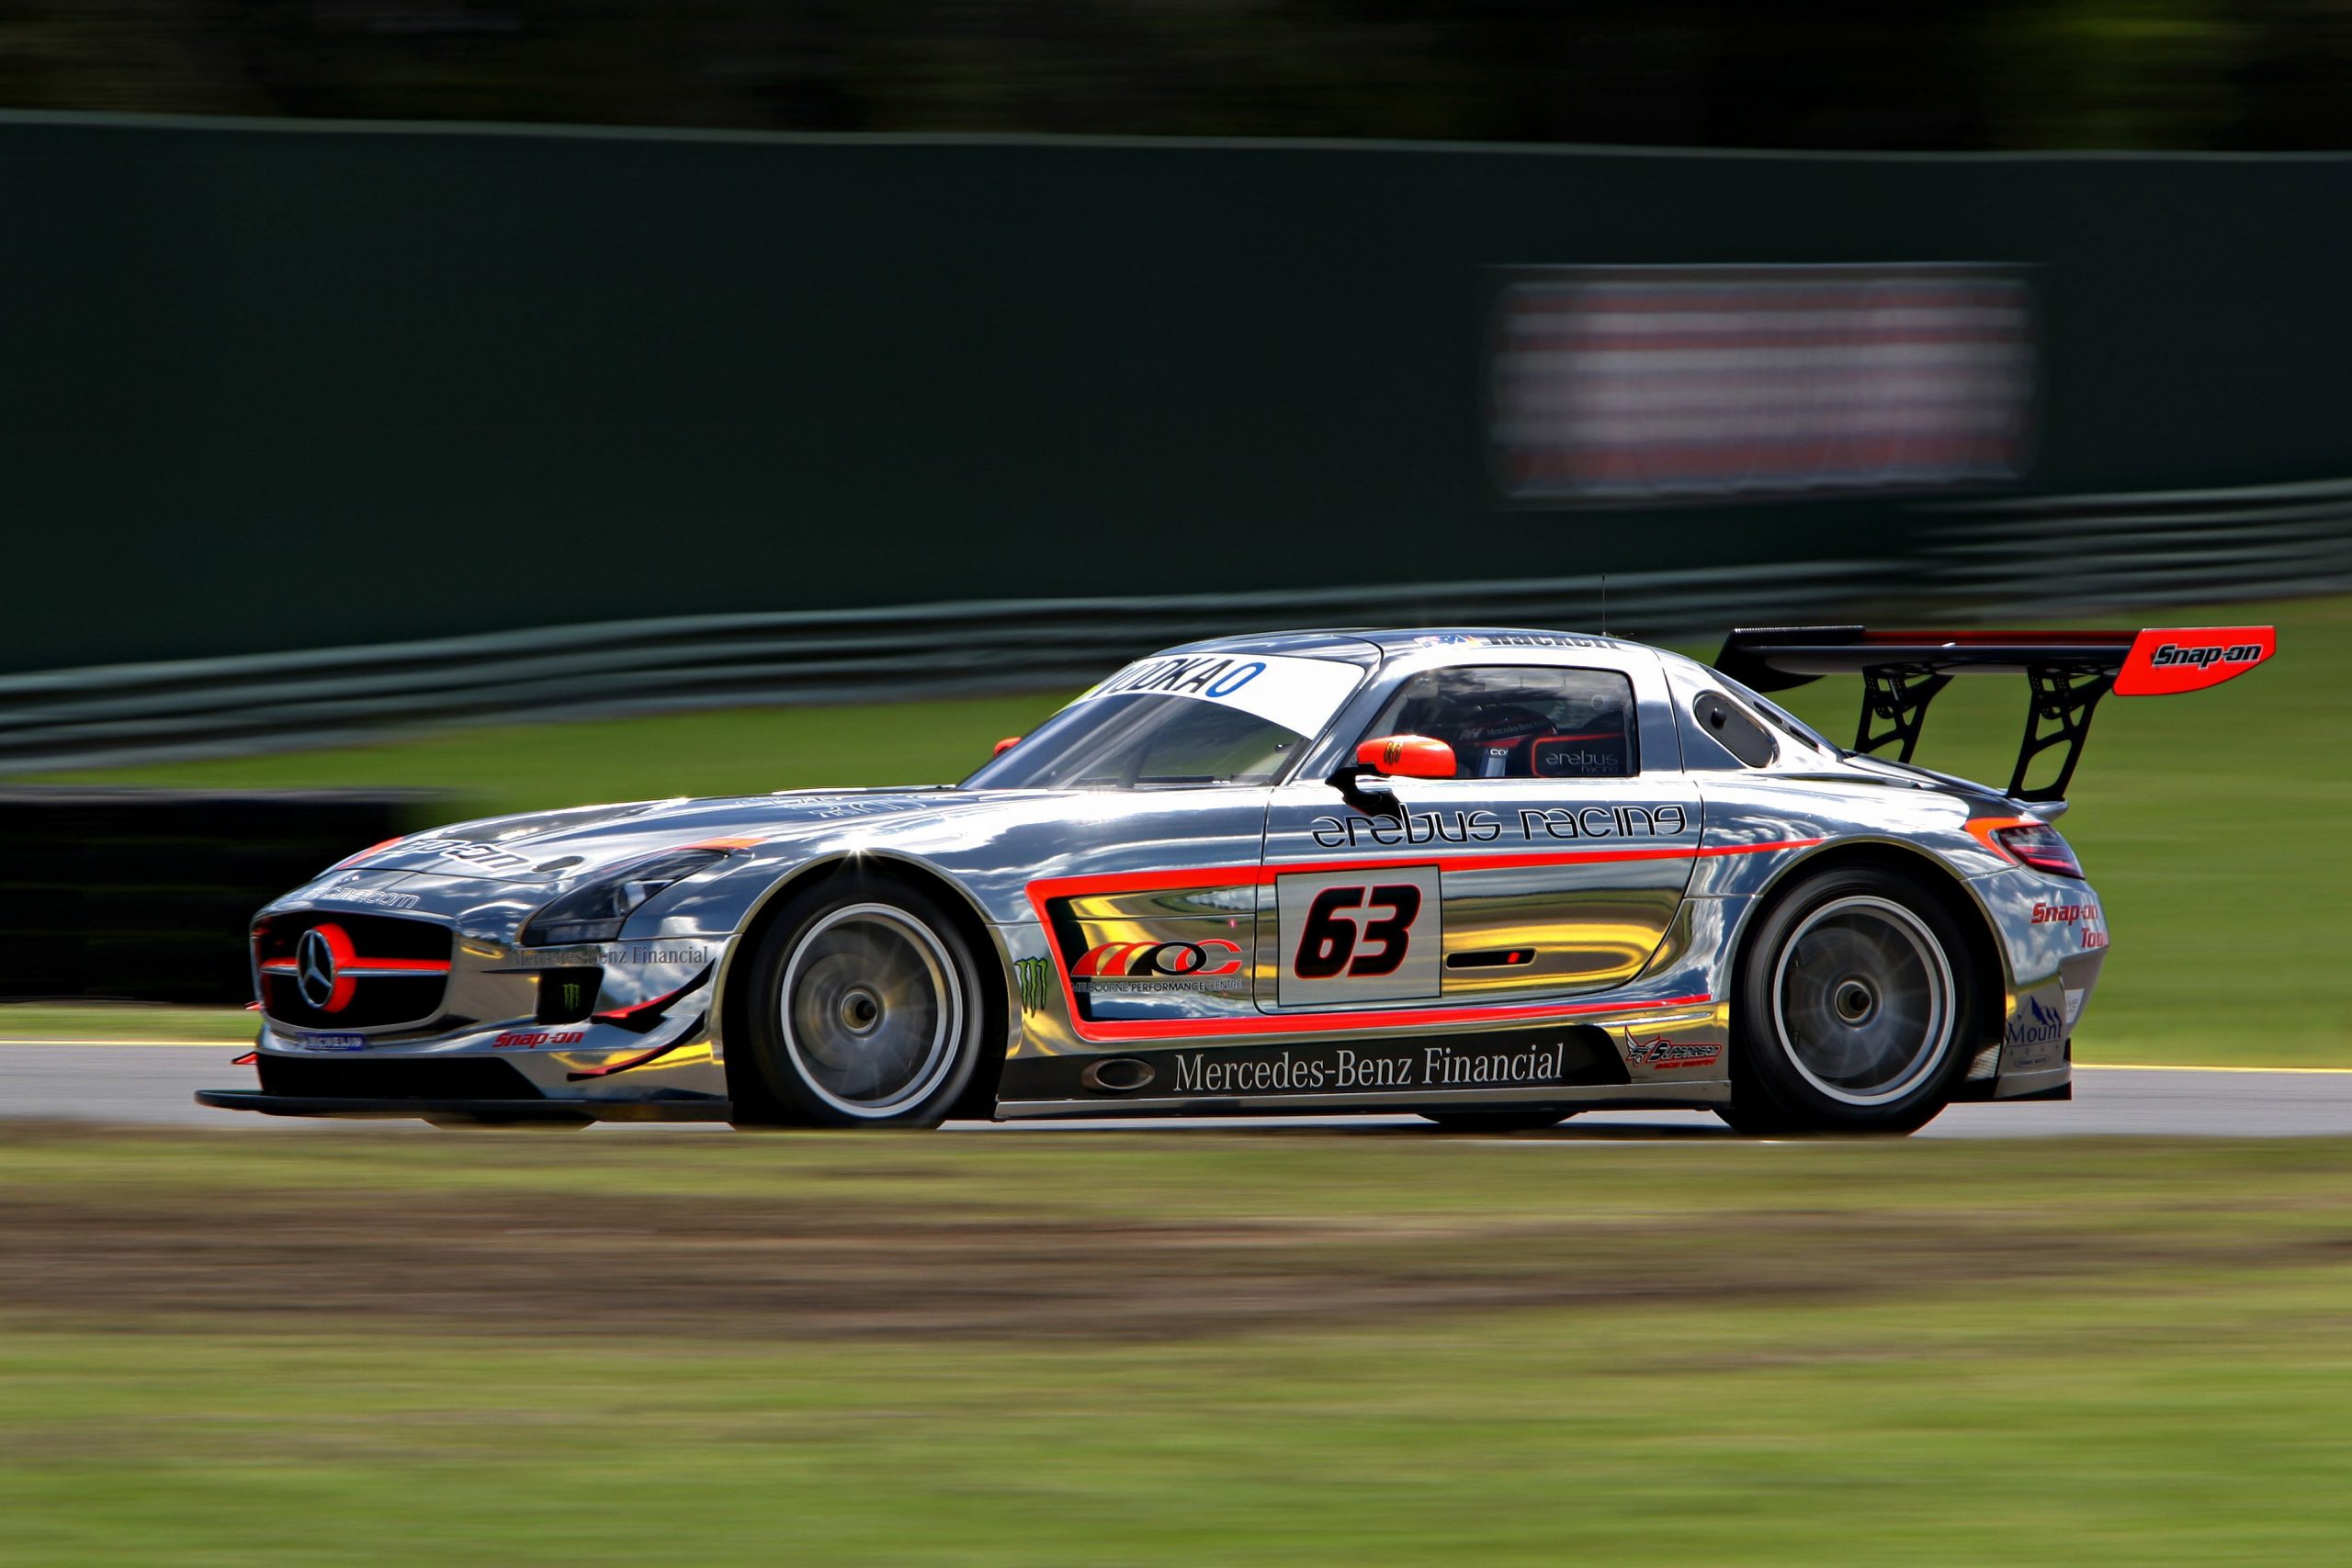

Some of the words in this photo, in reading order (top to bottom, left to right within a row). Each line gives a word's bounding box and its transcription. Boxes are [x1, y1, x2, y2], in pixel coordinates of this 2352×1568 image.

[2152, 644, 2264, 671] Snap-on
[1545, 750, 1618, 765] erebus
[1311, 803, 1501, 848] erebus
[1517, 804, 1688, 841] racing
[2030, 902, 2098, 926] Snap-on
[1294, 884, 1422, 980] 63
[632, 945, 708, 964] Financial
[1130, 980, 1204, 993] PERFORMANCE
[1208, 979, 1243, 991] CENTRE
[492, 1031, 584, 1049] Snap-on
[2007, 1019, 2062, 1044] Mount
[1172, 1049, 1412, 1092] Mercedes-Benz
[1423, 1043, 1564, 1085] Financial
